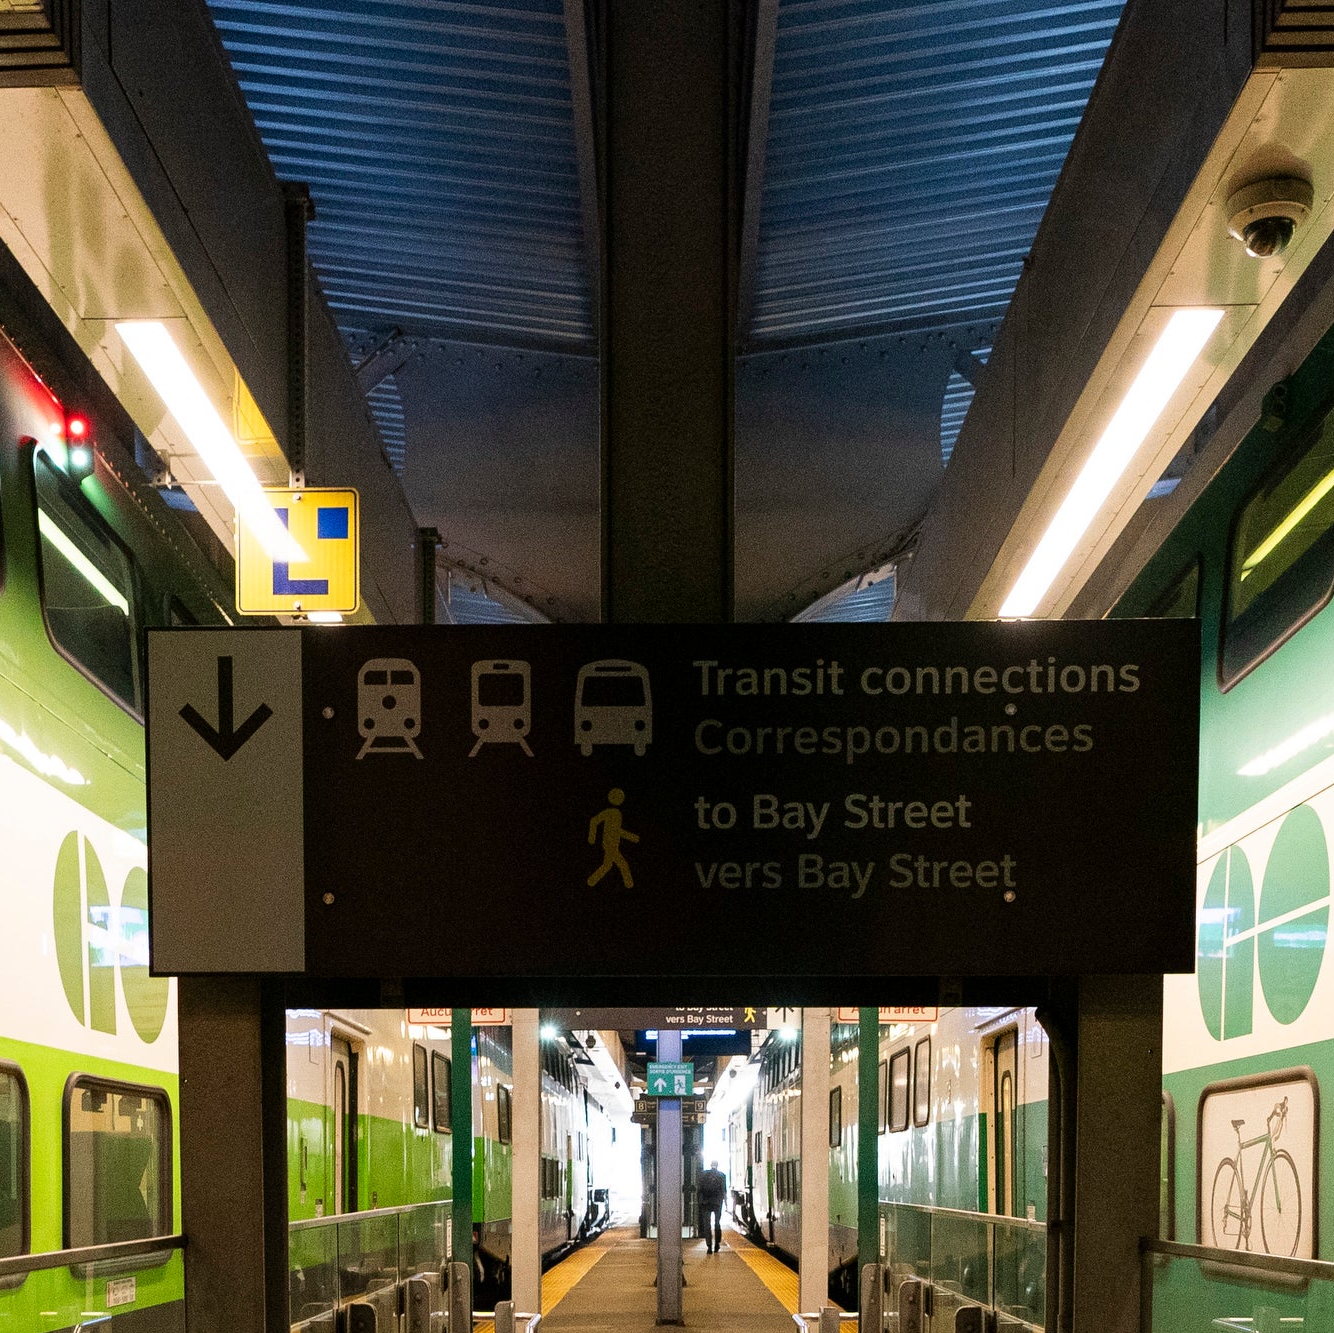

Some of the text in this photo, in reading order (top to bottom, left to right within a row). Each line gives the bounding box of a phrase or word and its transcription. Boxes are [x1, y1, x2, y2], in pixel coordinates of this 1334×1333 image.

[692, 656, 1142, 696] Transit connections
[694, 715, 1095, 765] Correspondances
[693, 793, 973, 840] to Bay Street
[694, 852, 1017, 899] vers Bay Street
[421, 1007, 453, 1017] Aucu
[666, 1014, 734, 1026] vers Bay Street
